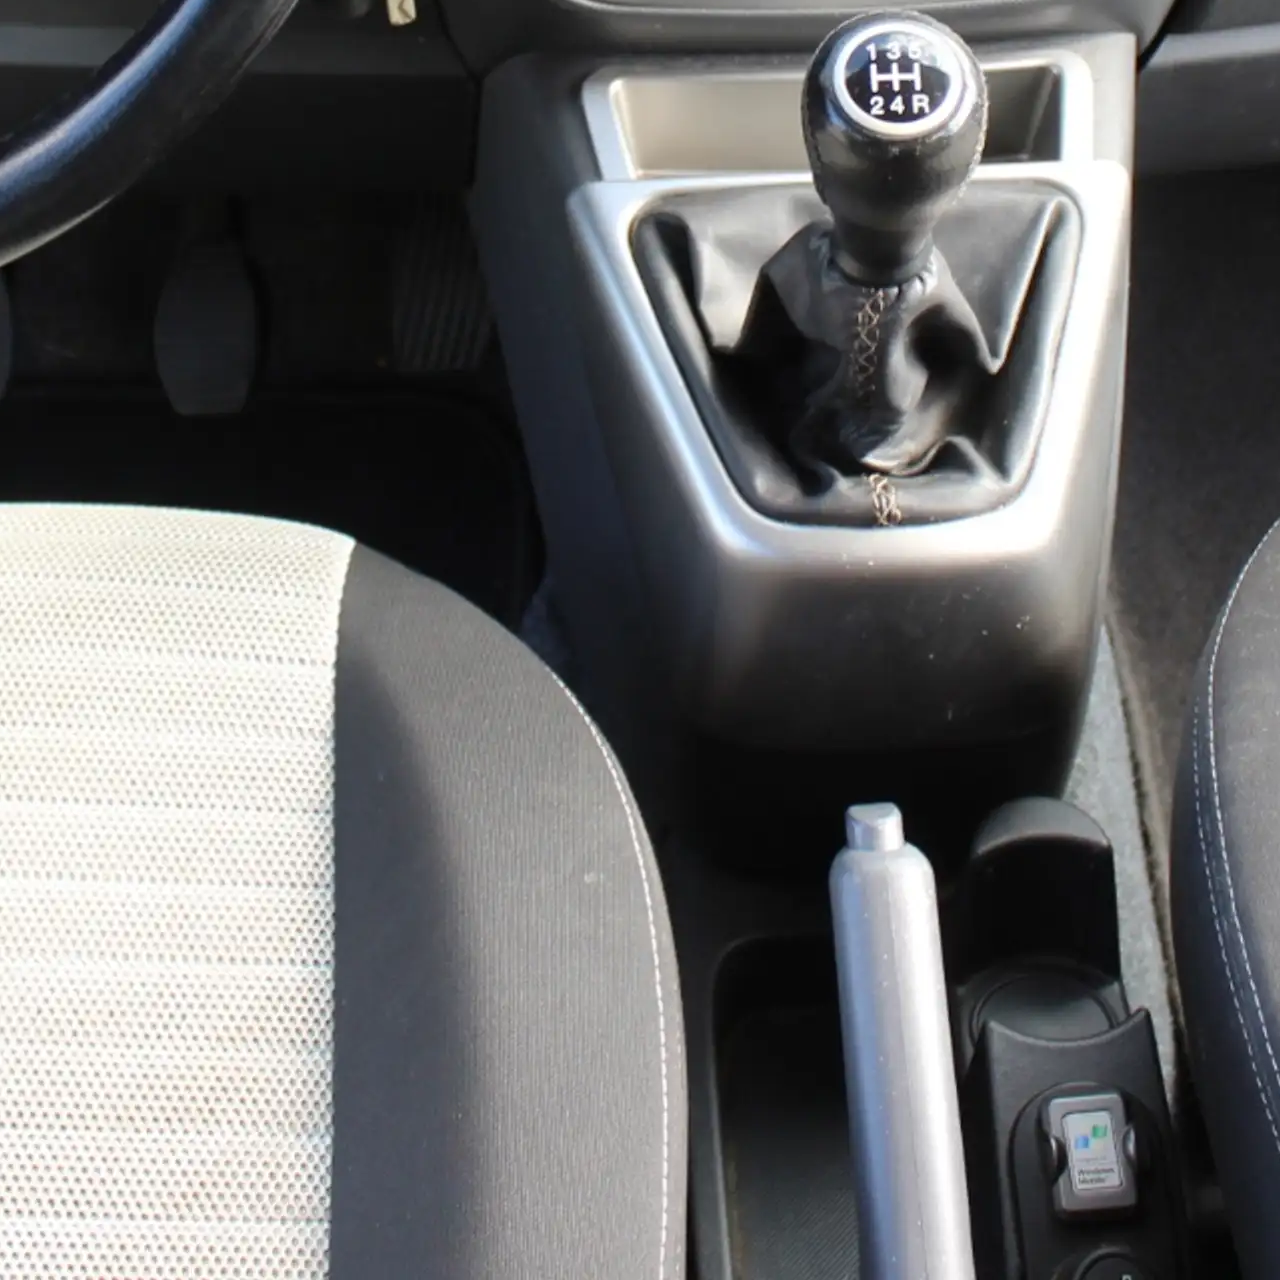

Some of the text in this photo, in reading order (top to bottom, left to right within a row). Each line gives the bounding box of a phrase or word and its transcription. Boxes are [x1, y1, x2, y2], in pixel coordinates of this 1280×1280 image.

[866, 43, 877, 61] 1
[886, 41, 901, 60] 3
[870, 93, 930, 116] 2 4 R
